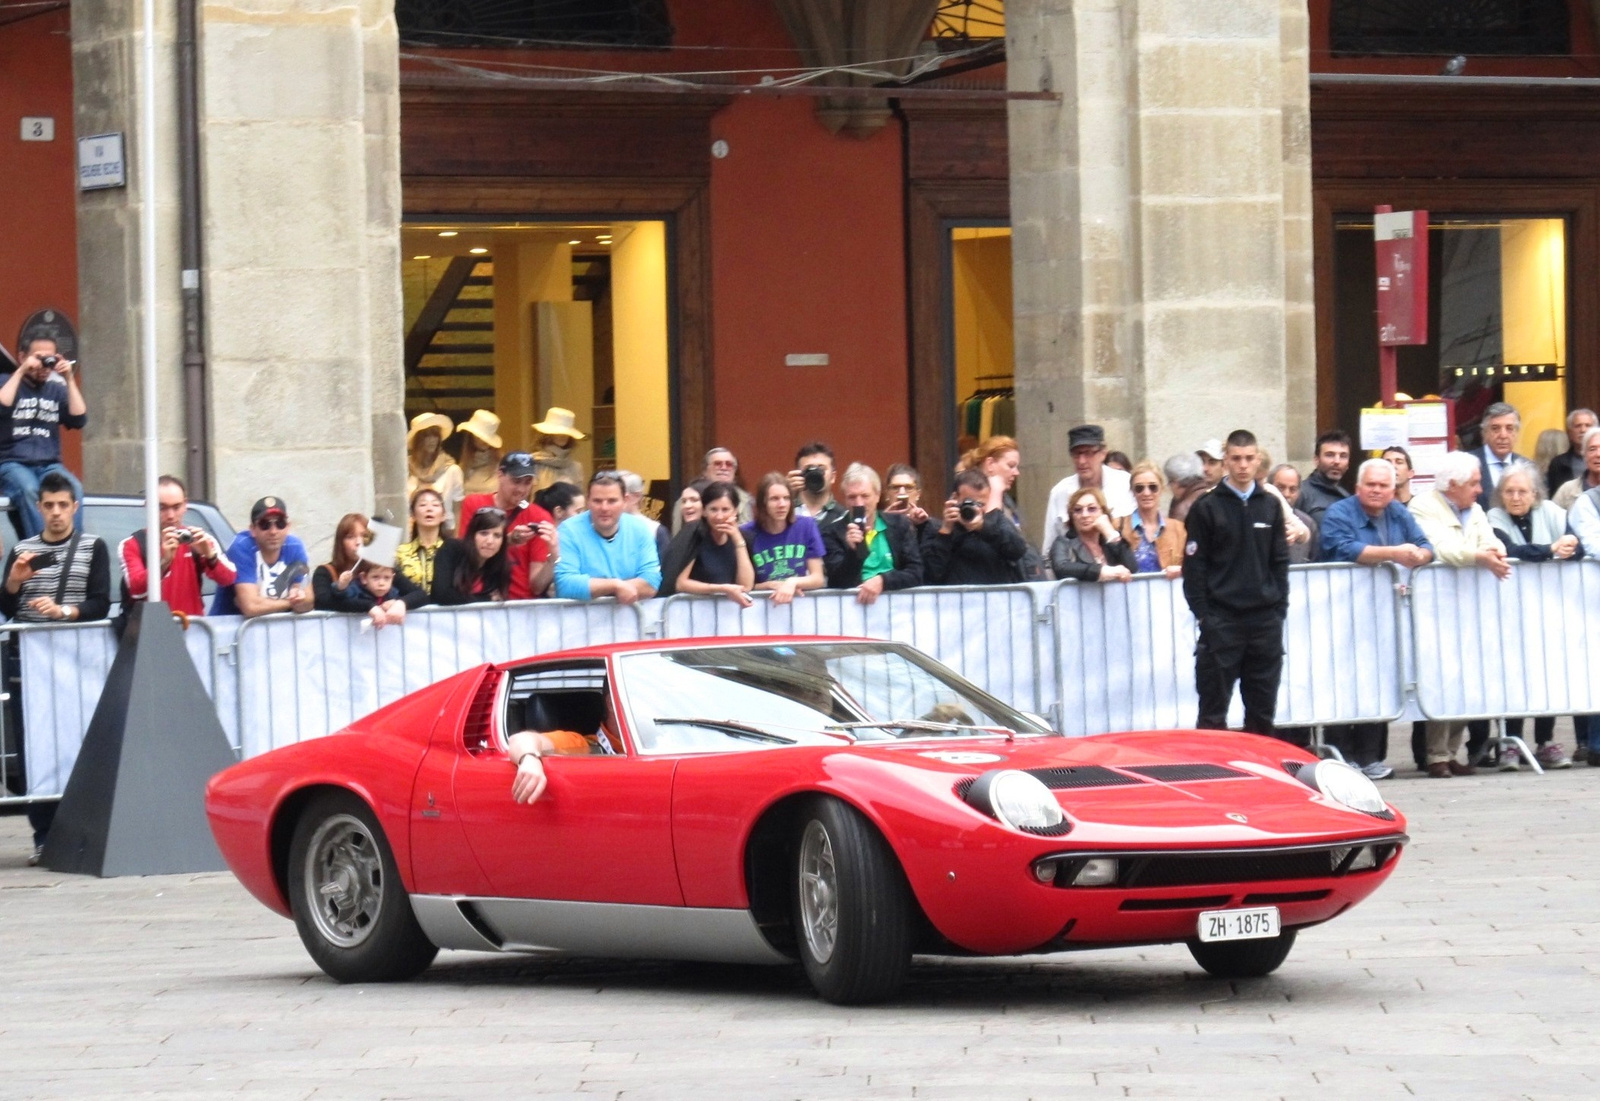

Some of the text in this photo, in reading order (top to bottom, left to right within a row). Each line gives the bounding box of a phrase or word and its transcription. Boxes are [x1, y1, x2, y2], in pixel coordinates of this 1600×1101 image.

[32, 121, 44, 138] 3
[1454, 365, 1546, 377] SISLEY
[753, 544, 806, 568] BLEND
[1209, 913, 1270, 937] ZH 1875
